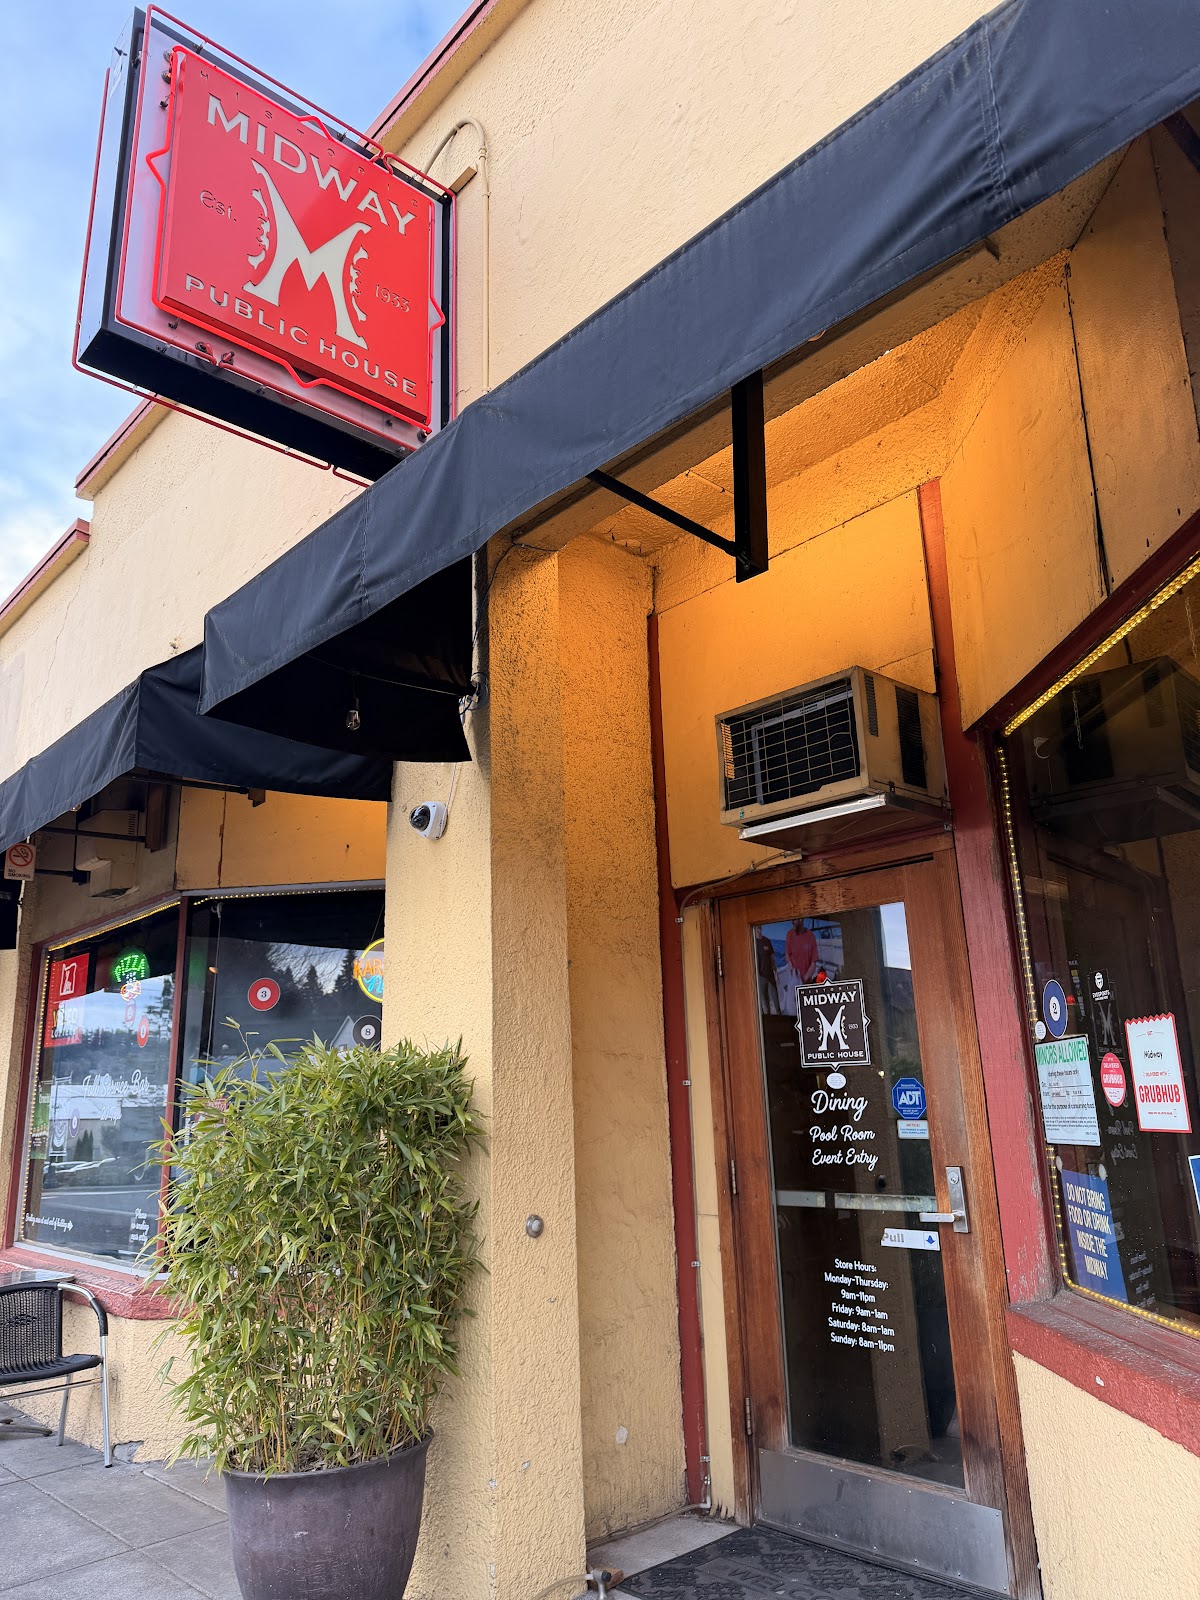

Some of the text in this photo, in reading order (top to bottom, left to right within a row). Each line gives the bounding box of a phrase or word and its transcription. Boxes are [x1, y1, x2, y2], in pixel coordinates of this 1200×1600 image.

[207, 92, 417, 236] MIDWAY
[374, 284, 411, 313] 1933
[184, 273, 418, 398] PUBLIC HOUSE
[114, 954, 146, 983] PIZZA
[800, 985, 858, 995] HISTORIC
[803, 991, 857, 1007] MIDWAY
[807, 1050, 865, 1060] PUBLIC HOUSE
[1036, 1040, 1088, 1066] MINORS ALLOWED
[1143, 1049, 1163, 1060] Midway
[131, 1069, 150, 1095] Bar
[899, 1090, 921, 1106] ADT
[1138, 1083, 1181, 1104] GRUBHUB
[810, 1089, 868, 1121] Dining
[809, 1124, 876, 1142] Pool Room
[811, 1147, 879, 1171] Event Entry
[1066, 1182, 1106, 1212] DO NOT BRING
[1067, 1204, 1112, 1235] FOOD OR DRINK
[1076, 1229, 1096, 1253] INSIDE
[1093, 1235, 1108, 1258] THE
[834, 1258, 877, 1273] Store Hours:
[1084, 1254, 1109, 1280] MIDWAY
[824, 1271, 889, 1291] Monday-Thursday:
[840, 1288, 876, 1304] 9am-11pm
[831, 1302, 889, 1320] Friday: 9am-1am
[827, 1316, 895, 1337] Saturday: 8am-1am
[830, 1331, 895, 1352] Sunday: 8am-11pm
